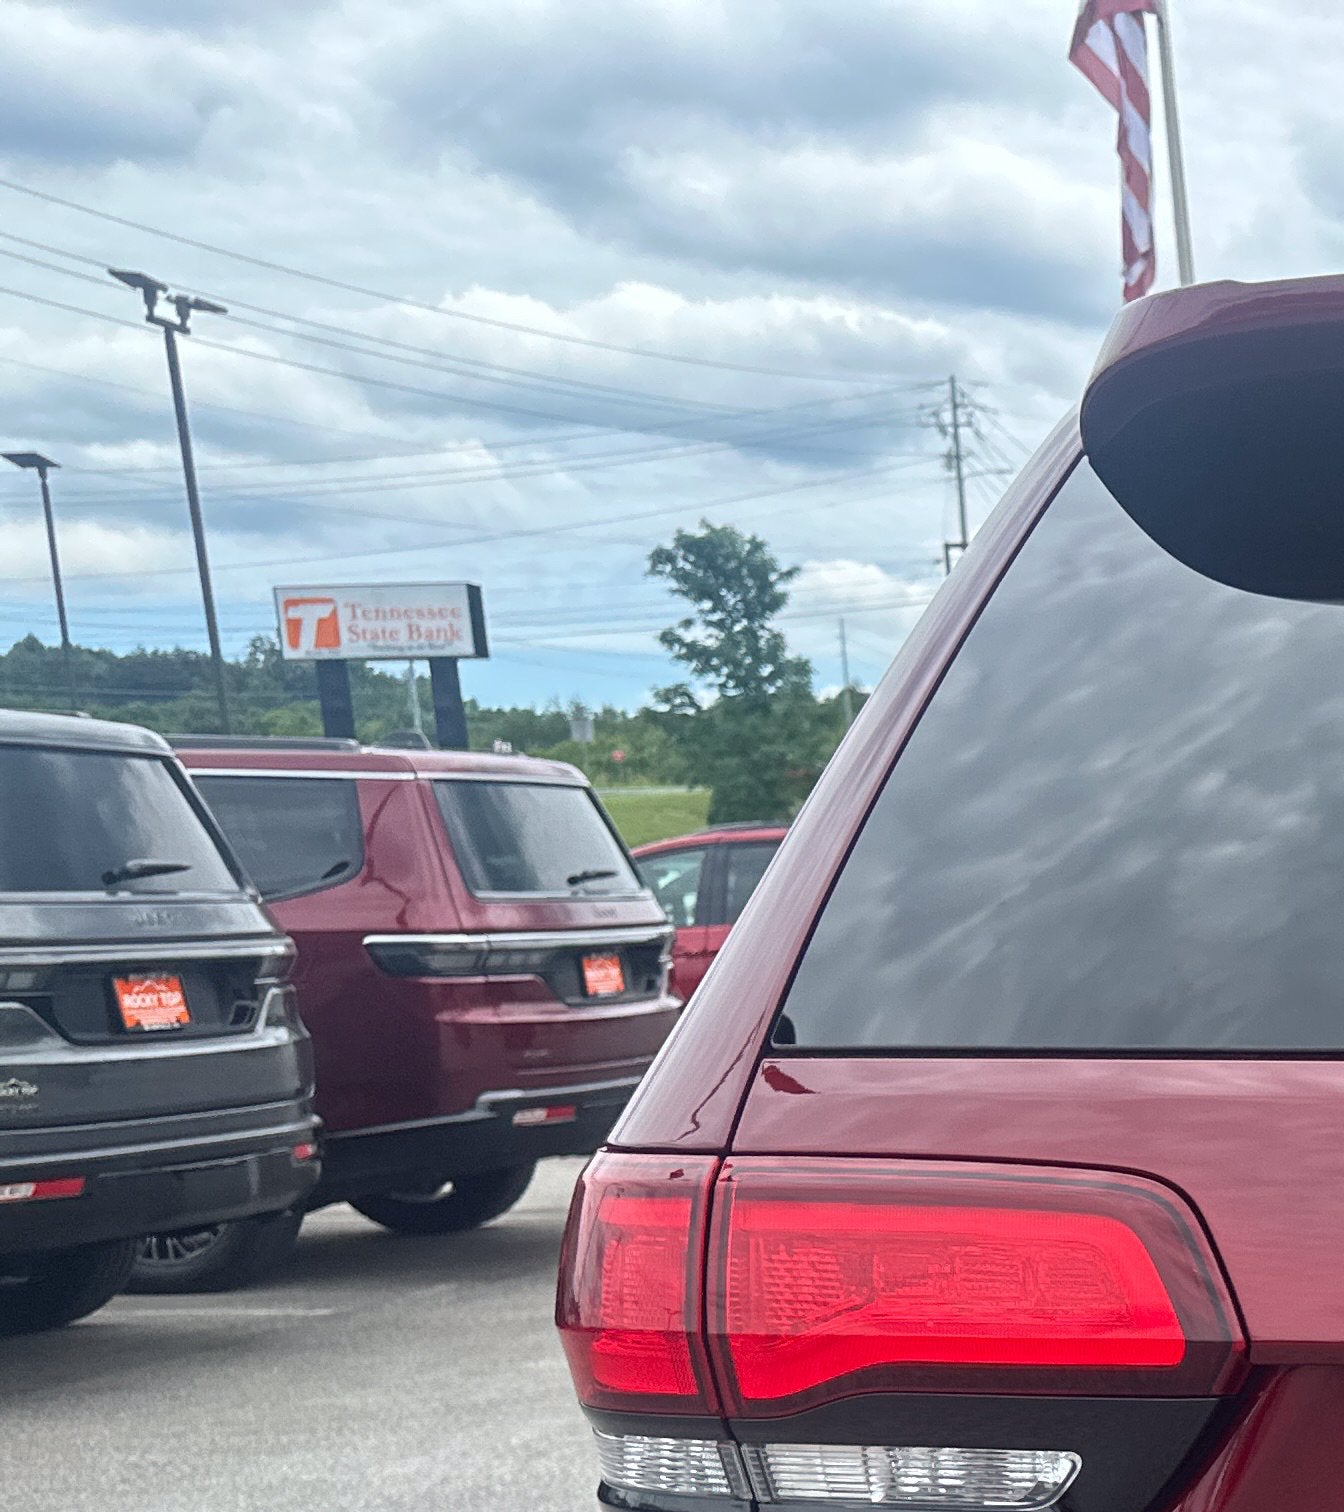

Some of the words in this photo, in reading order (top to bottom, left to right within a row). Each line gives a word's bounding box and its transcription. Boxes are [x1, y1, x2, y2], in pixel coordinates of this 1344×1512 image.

[345, 602, 462, 621] Tennessee
[347, 621, 400, 642] State
[407, 620, 463, 641] Bank
